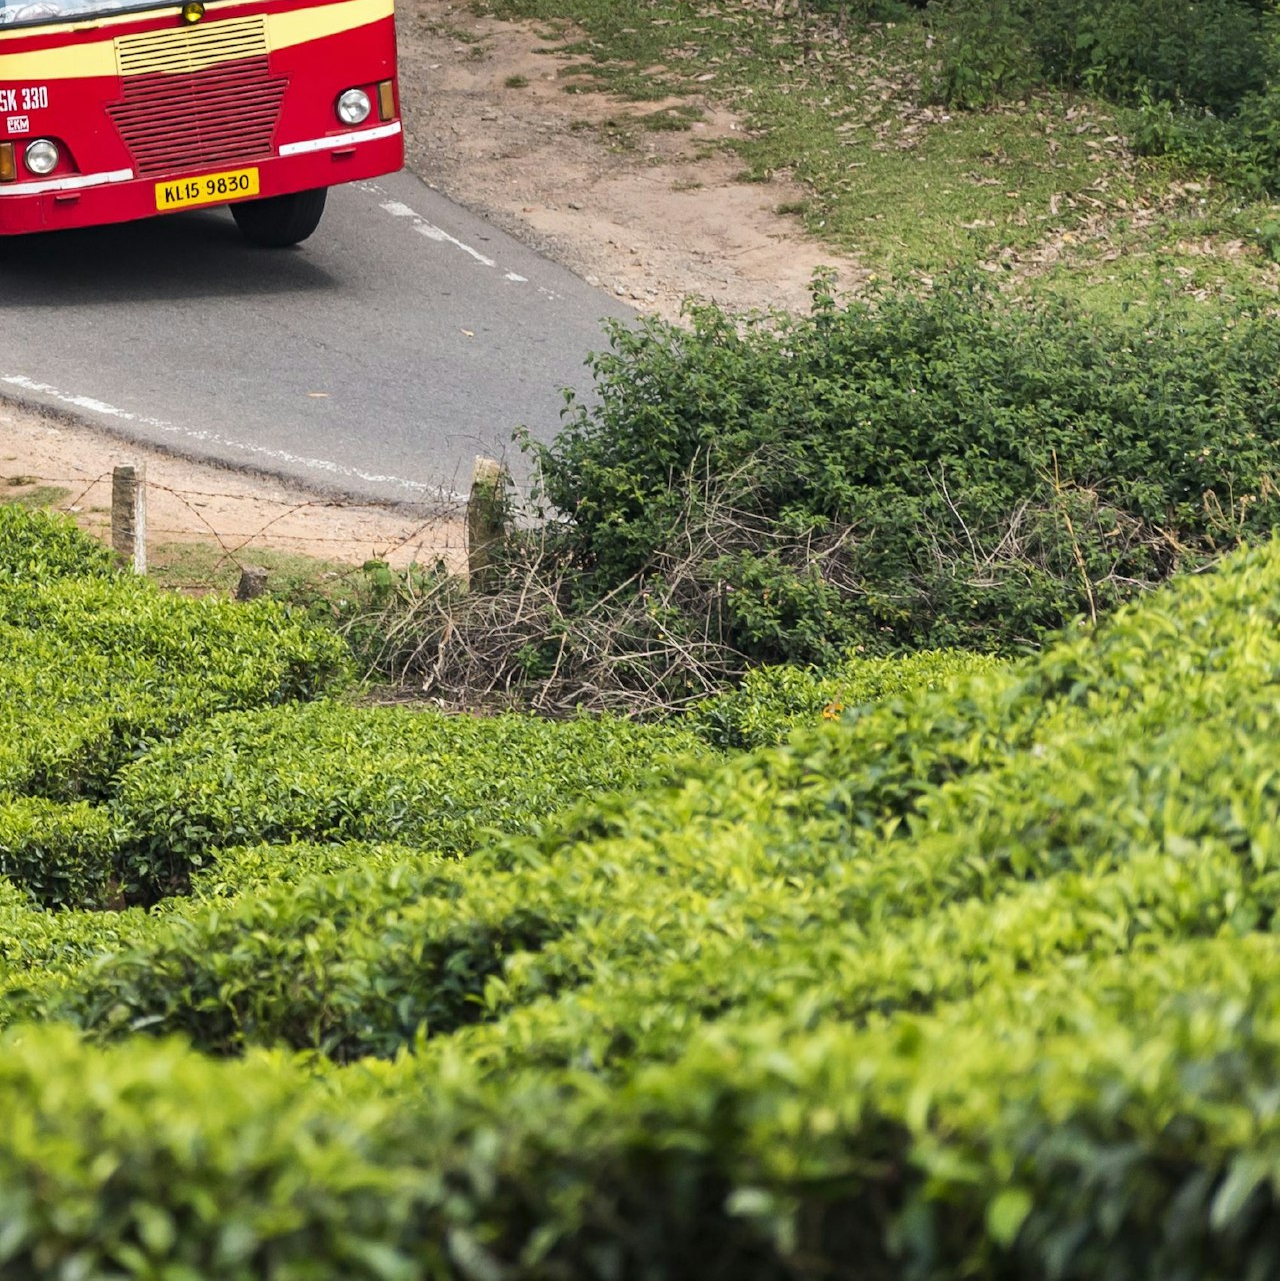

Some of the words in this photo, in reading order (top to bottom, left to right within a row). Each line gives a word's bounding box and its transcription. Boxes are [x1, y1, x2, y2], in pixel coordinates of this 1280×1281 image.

[21, 86, 48, 110] 330
[165, 182, 199, 203] KL15
[206, 174, 249, 195] 9830
